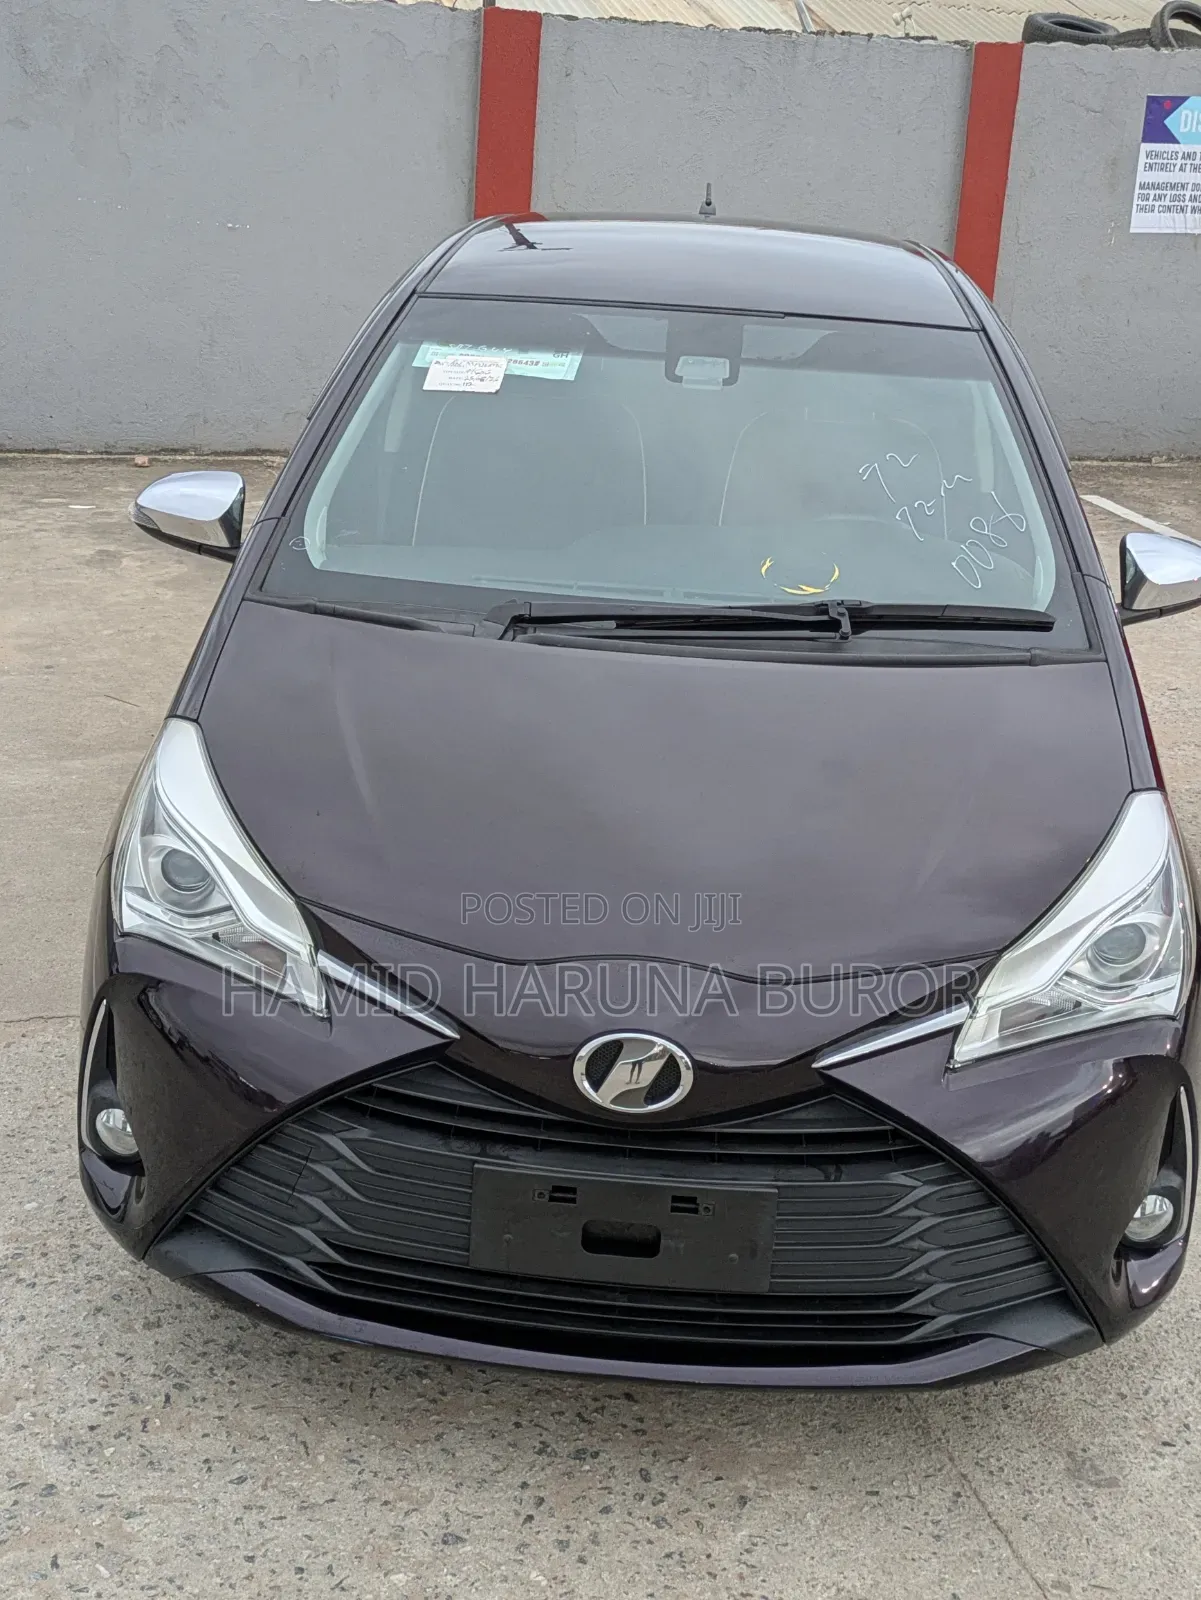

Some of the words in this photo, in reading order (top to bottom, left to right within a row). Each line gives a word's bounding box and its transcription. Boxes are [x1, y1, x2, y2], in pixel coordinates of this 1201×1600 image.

[1145, 150, 1179, 161] VEHICLES
[1180, 151, 1197, 161] AND
[1143, 161, 1177, 173] ENTIRELY
[1178, 163, 1188, 173] AT
[1138, 181, 1190, 192] MANAGEMENT
[1137, 192, 1151, 203] FOR
[1151, 193, 1168, 203] ANY
[1169, 193, 1187, 203] LOSS
[1135, 203, 1156, 214] THEIR
[1157, 204, 1189, 215] CONTENT
